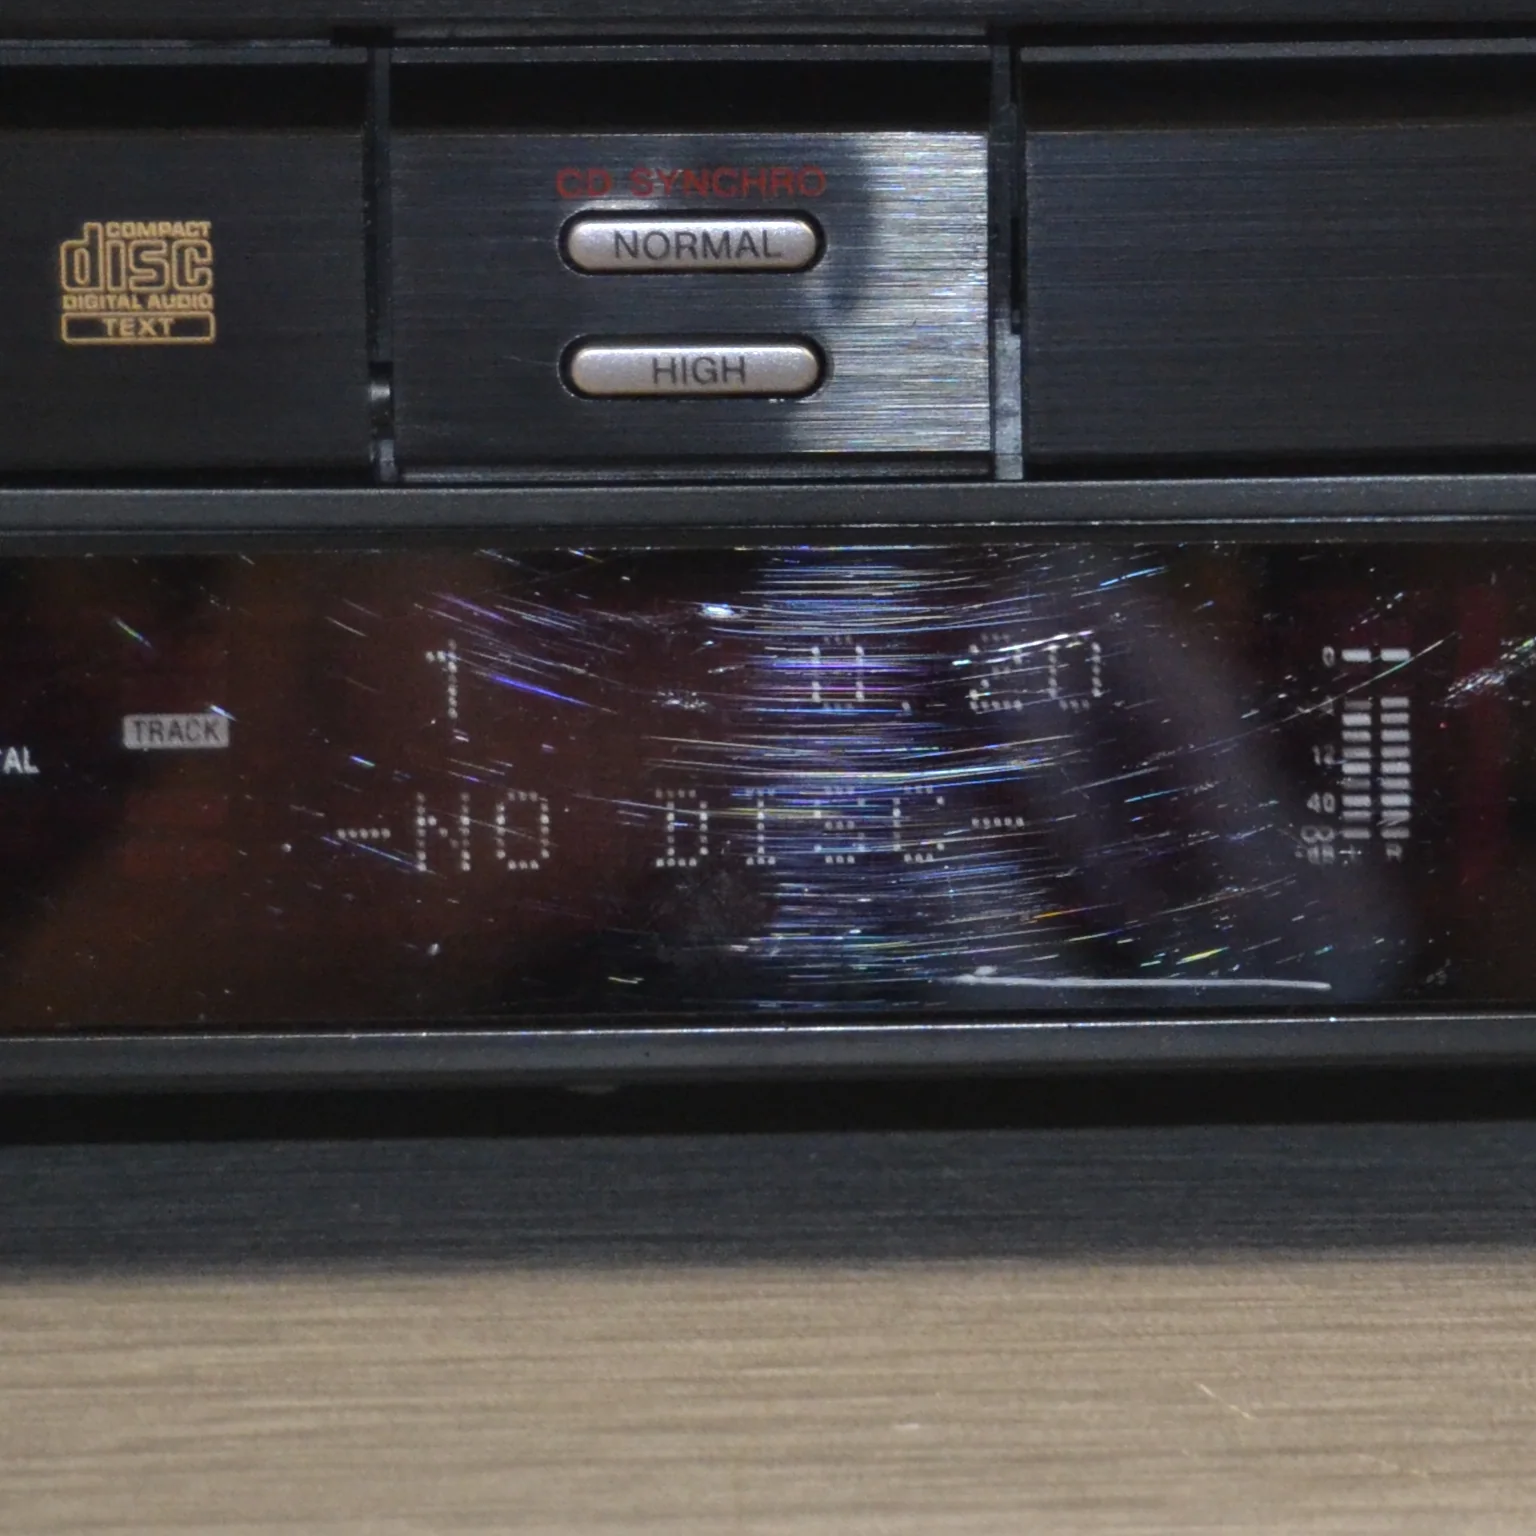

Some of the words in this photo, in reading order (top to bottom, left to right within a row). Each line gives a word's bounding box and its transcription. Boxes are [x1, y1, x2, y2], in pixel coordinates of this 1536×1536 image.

[556, 168, 611, 198] CD
[630, 166, 827, 197] SYNCHRO
[106, 221, 211, 238] COMPACT
[614, 229, 782, 260] NORMAL
[62, 294, 140, 310] DIGITAL
[147, 294, 214, 310] AUDIO
[102, 317, 175, 337] TEXT
[652, 357, 746, 385] HIGH
[132, 719, 221, 743] TRACK
[0, 746, 40, 774] AL
